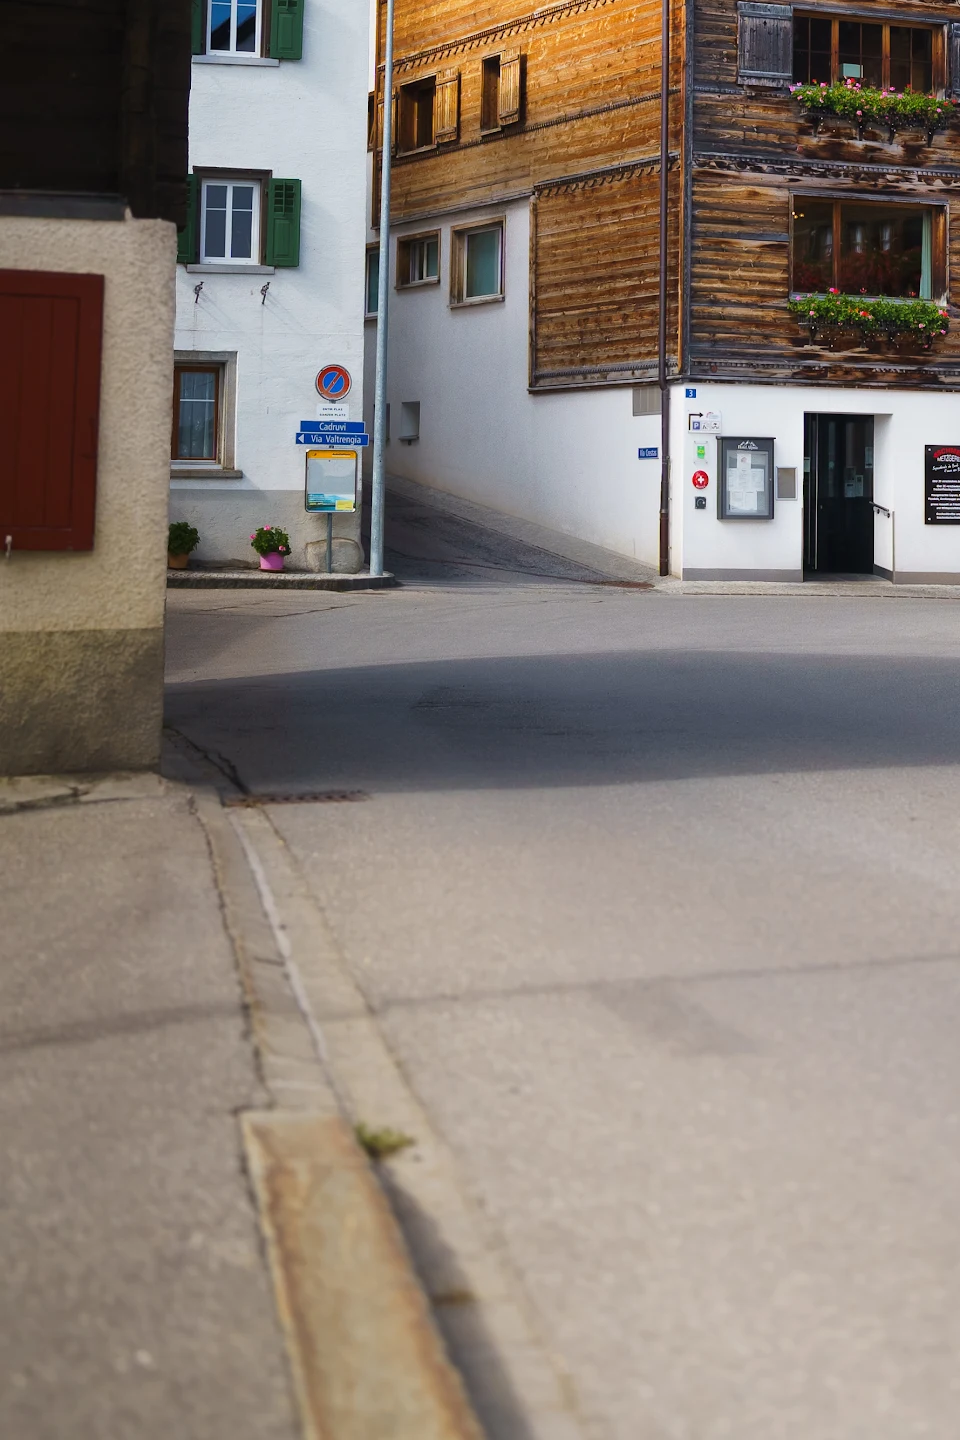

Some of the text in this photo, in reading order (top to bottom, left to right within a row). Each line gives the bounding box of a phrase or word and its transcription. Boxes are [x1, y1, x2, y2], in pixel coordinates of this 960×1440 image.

[689, 389, 693, 397] 3
[319, 422, 347, 431] Cadruvi
[311, 434, 362, 445] Via Valtrengia
